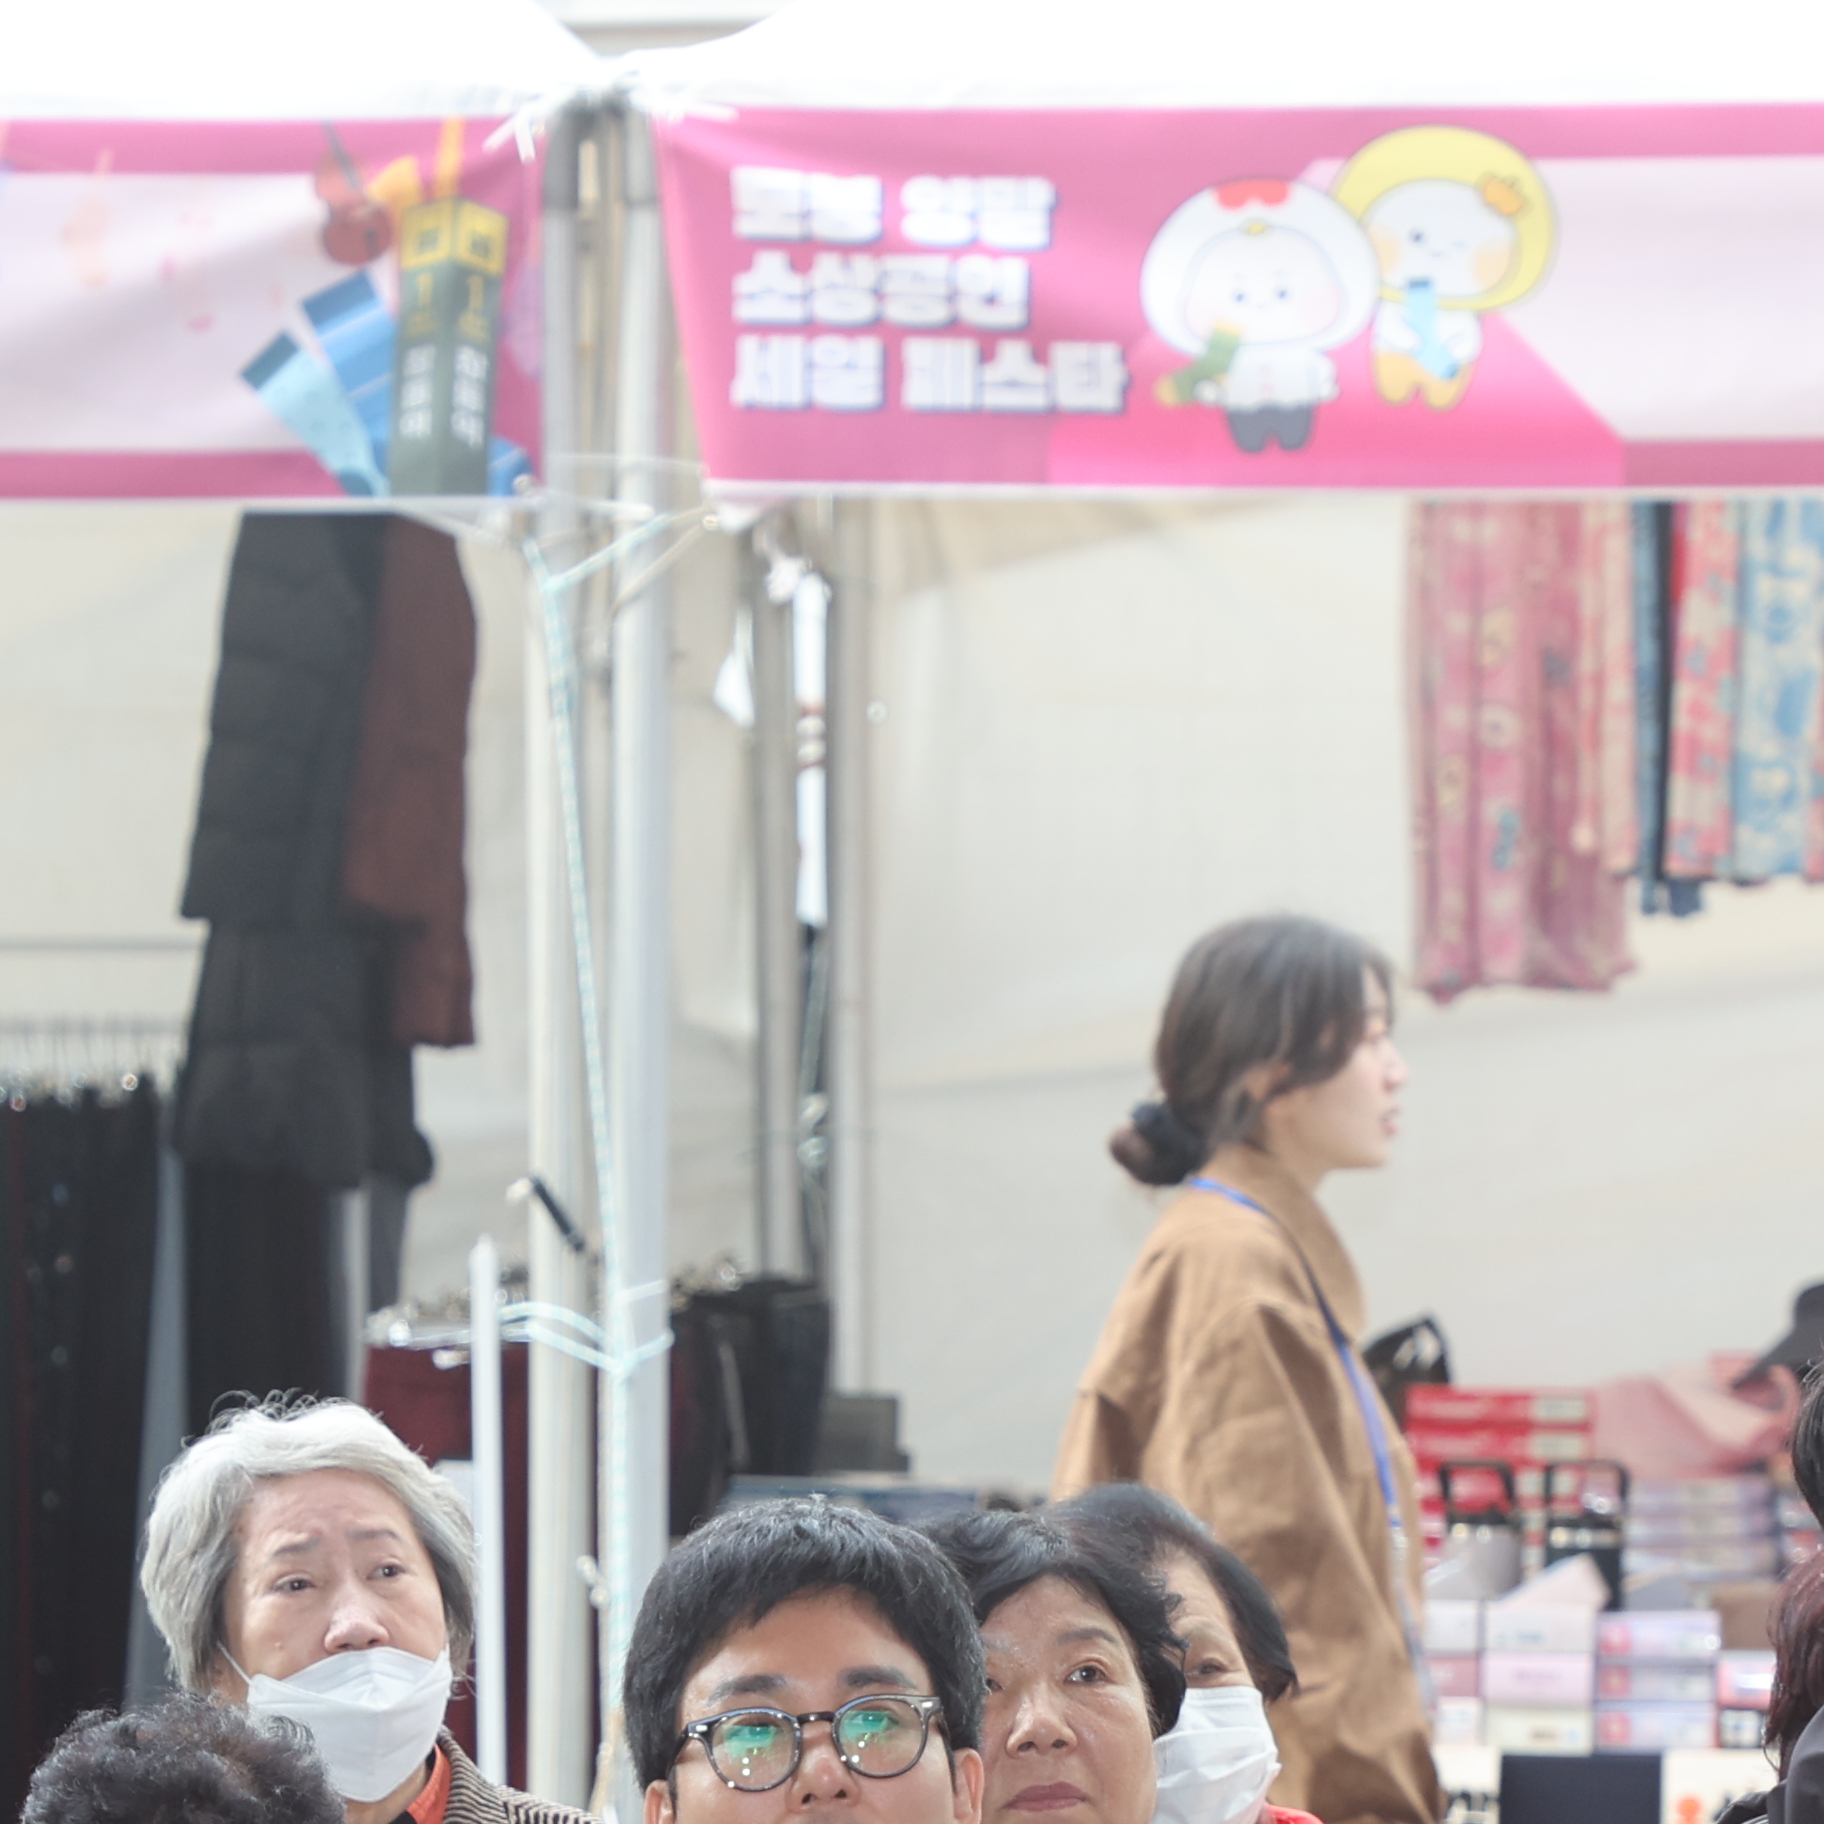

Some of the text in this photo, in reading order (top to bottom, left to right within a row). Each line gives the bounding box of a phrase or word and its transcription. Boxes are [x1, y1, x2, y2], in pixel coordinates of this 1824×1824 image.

[732, 250, 1030, 331] 소상공인
[730, 333, 1129, 414] 세일 페스타
